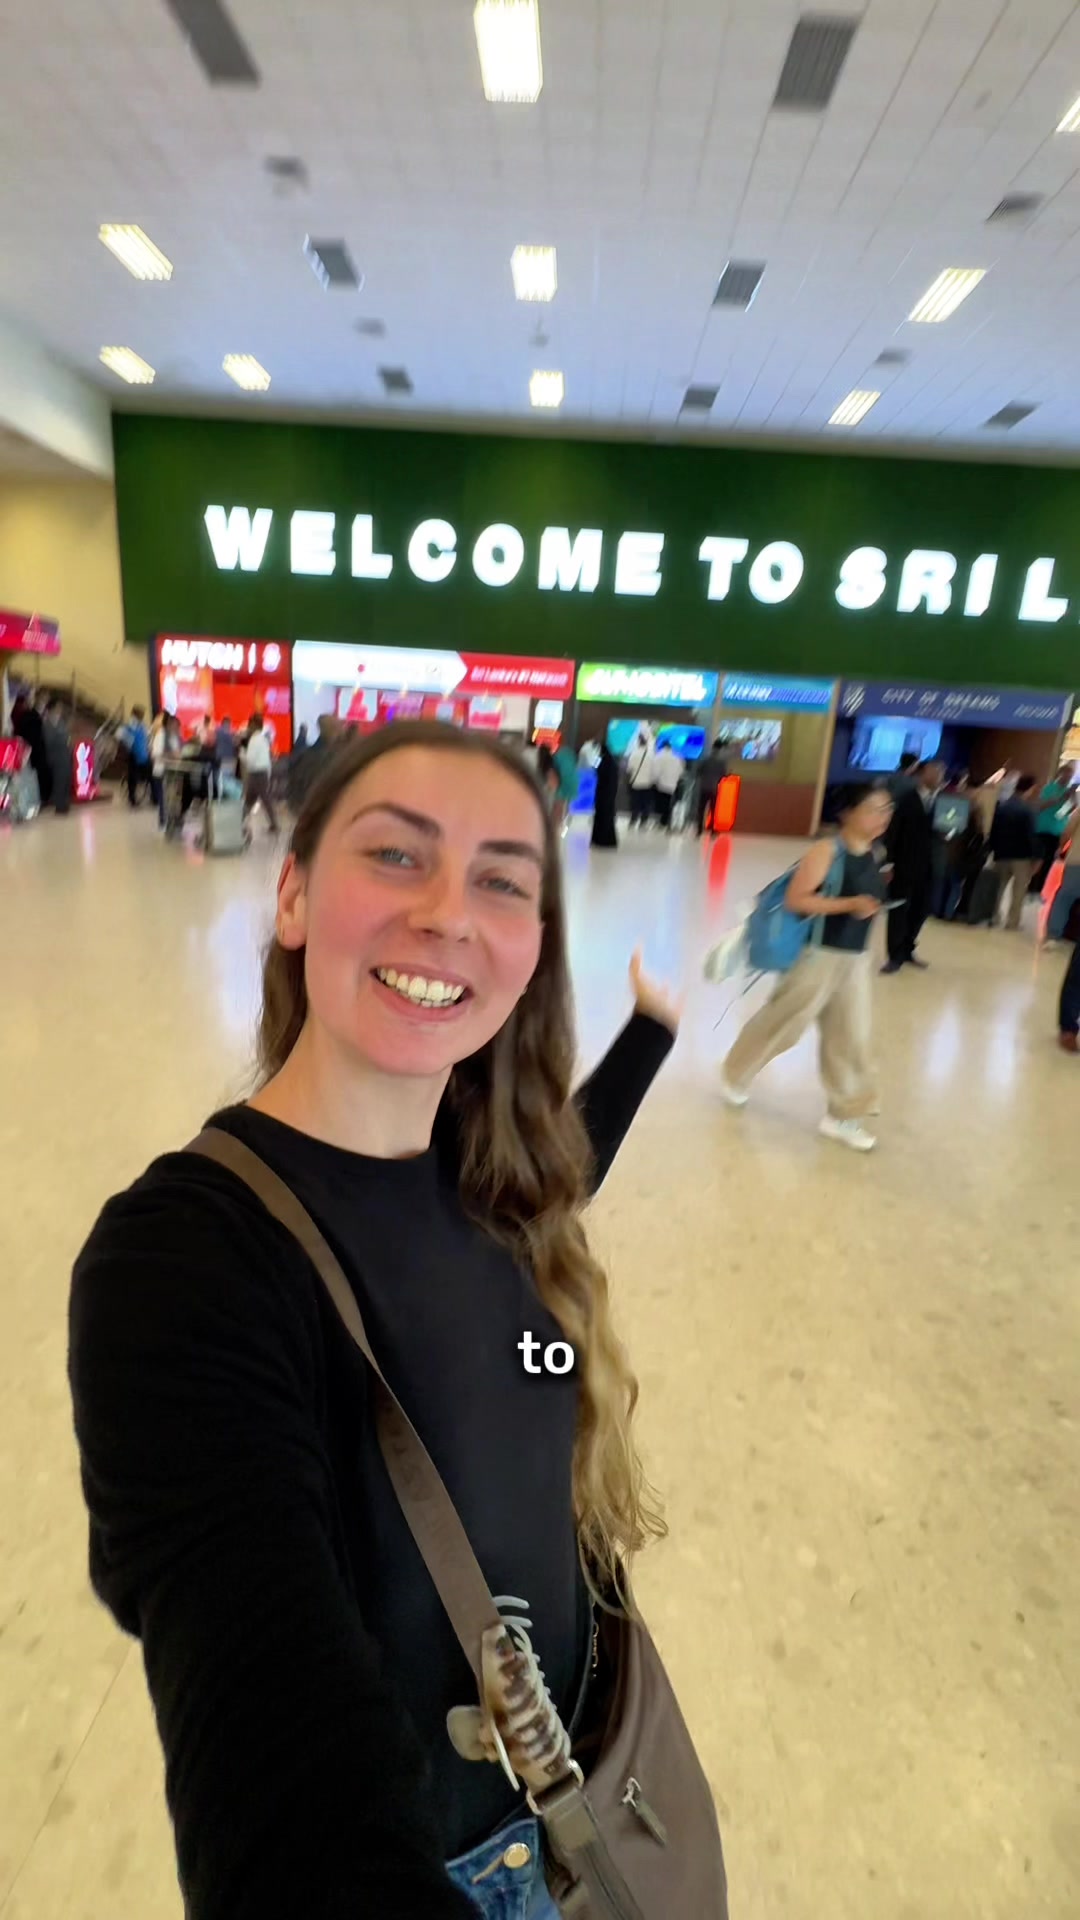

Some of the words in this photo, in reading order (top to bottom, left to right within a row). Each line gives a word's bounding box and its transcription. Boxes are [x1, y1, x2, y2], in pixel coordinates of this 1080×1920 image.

[203, 504, 665, 596] WELCOME
[698, 536, 804, 604] TO
[834, 546, 999, 617] SRI
[1018, 557, 1080, 624] L
